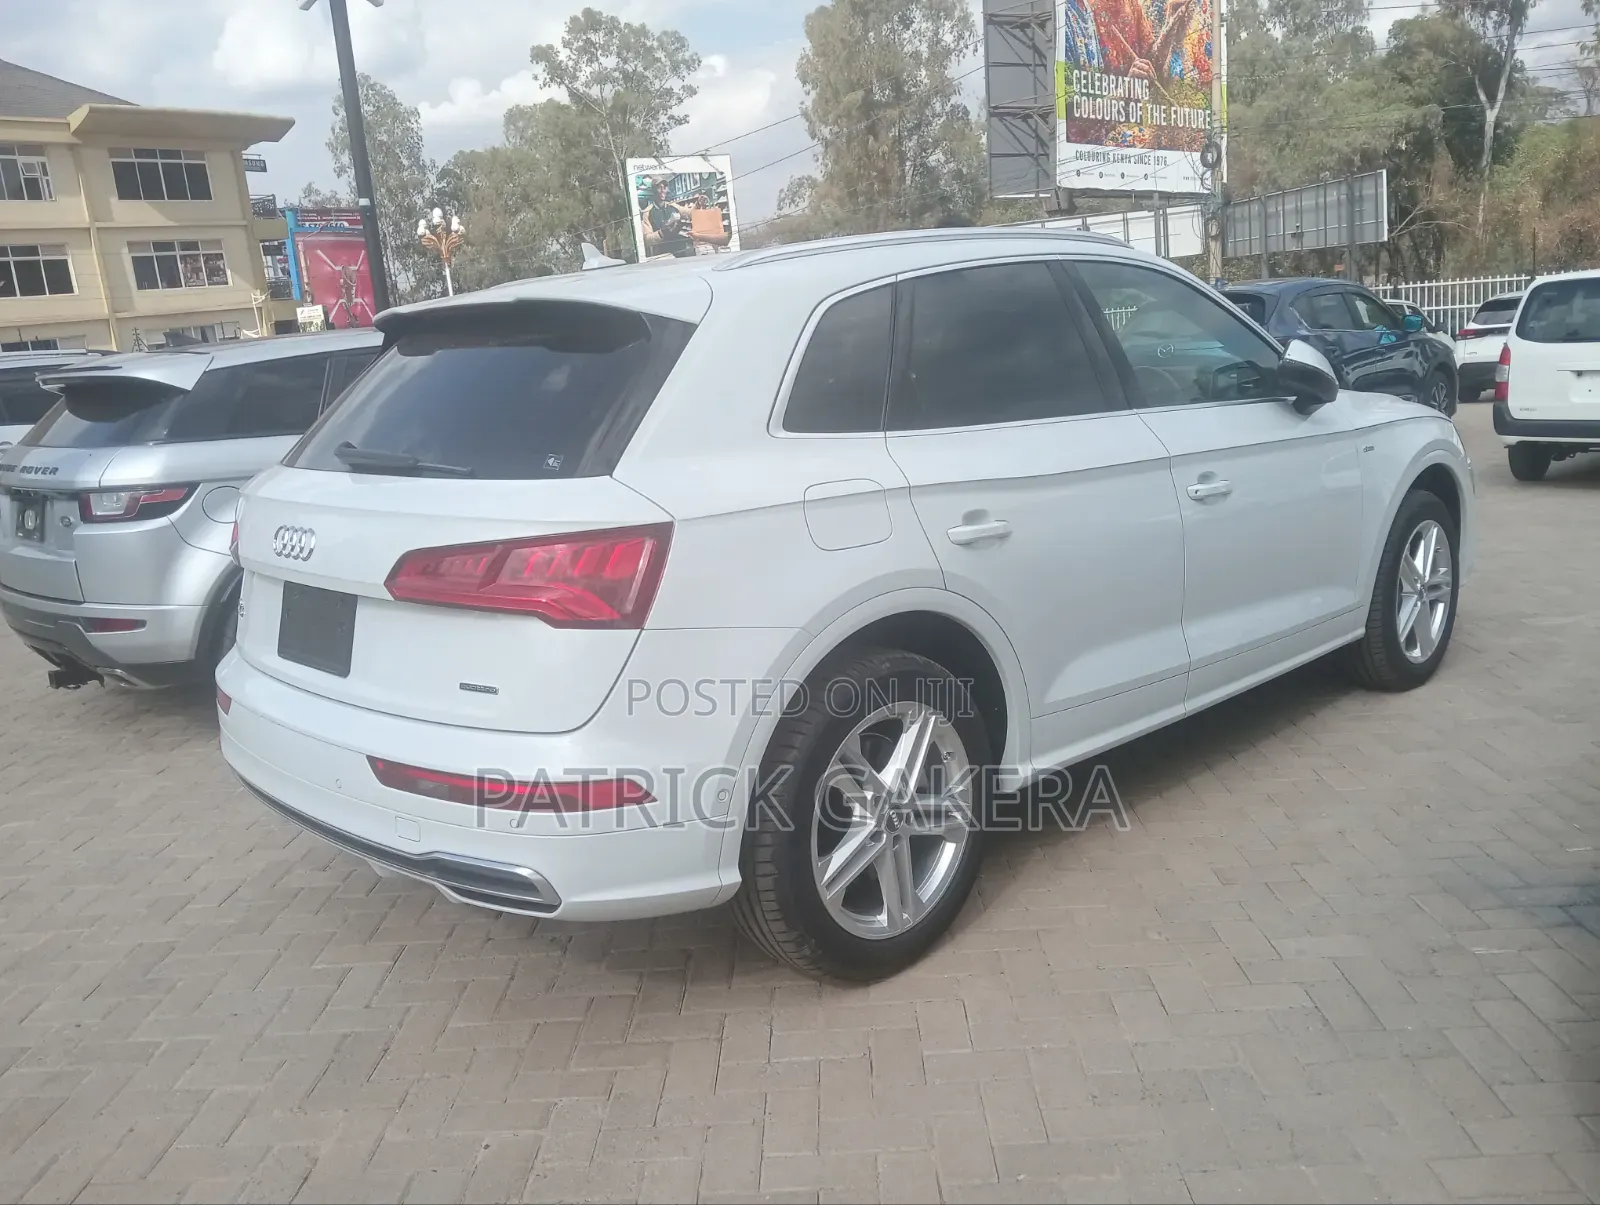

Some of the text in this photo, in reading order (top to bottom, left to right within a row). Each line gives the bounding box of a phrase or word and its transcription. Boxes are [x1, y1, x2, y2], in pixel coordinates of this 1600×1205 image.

[1073, 69, 1150, 101] CELEBRATING
[1073, 95, 1212, 129] COLOURS OF THE FUTURE
[1075, 150, 1111, 162] COLOURING
[1112, 152, 1132, 164] KENYA
[1134, 154, 1152, 165] SINCE
[20, 465, 59, 476] ROVER
